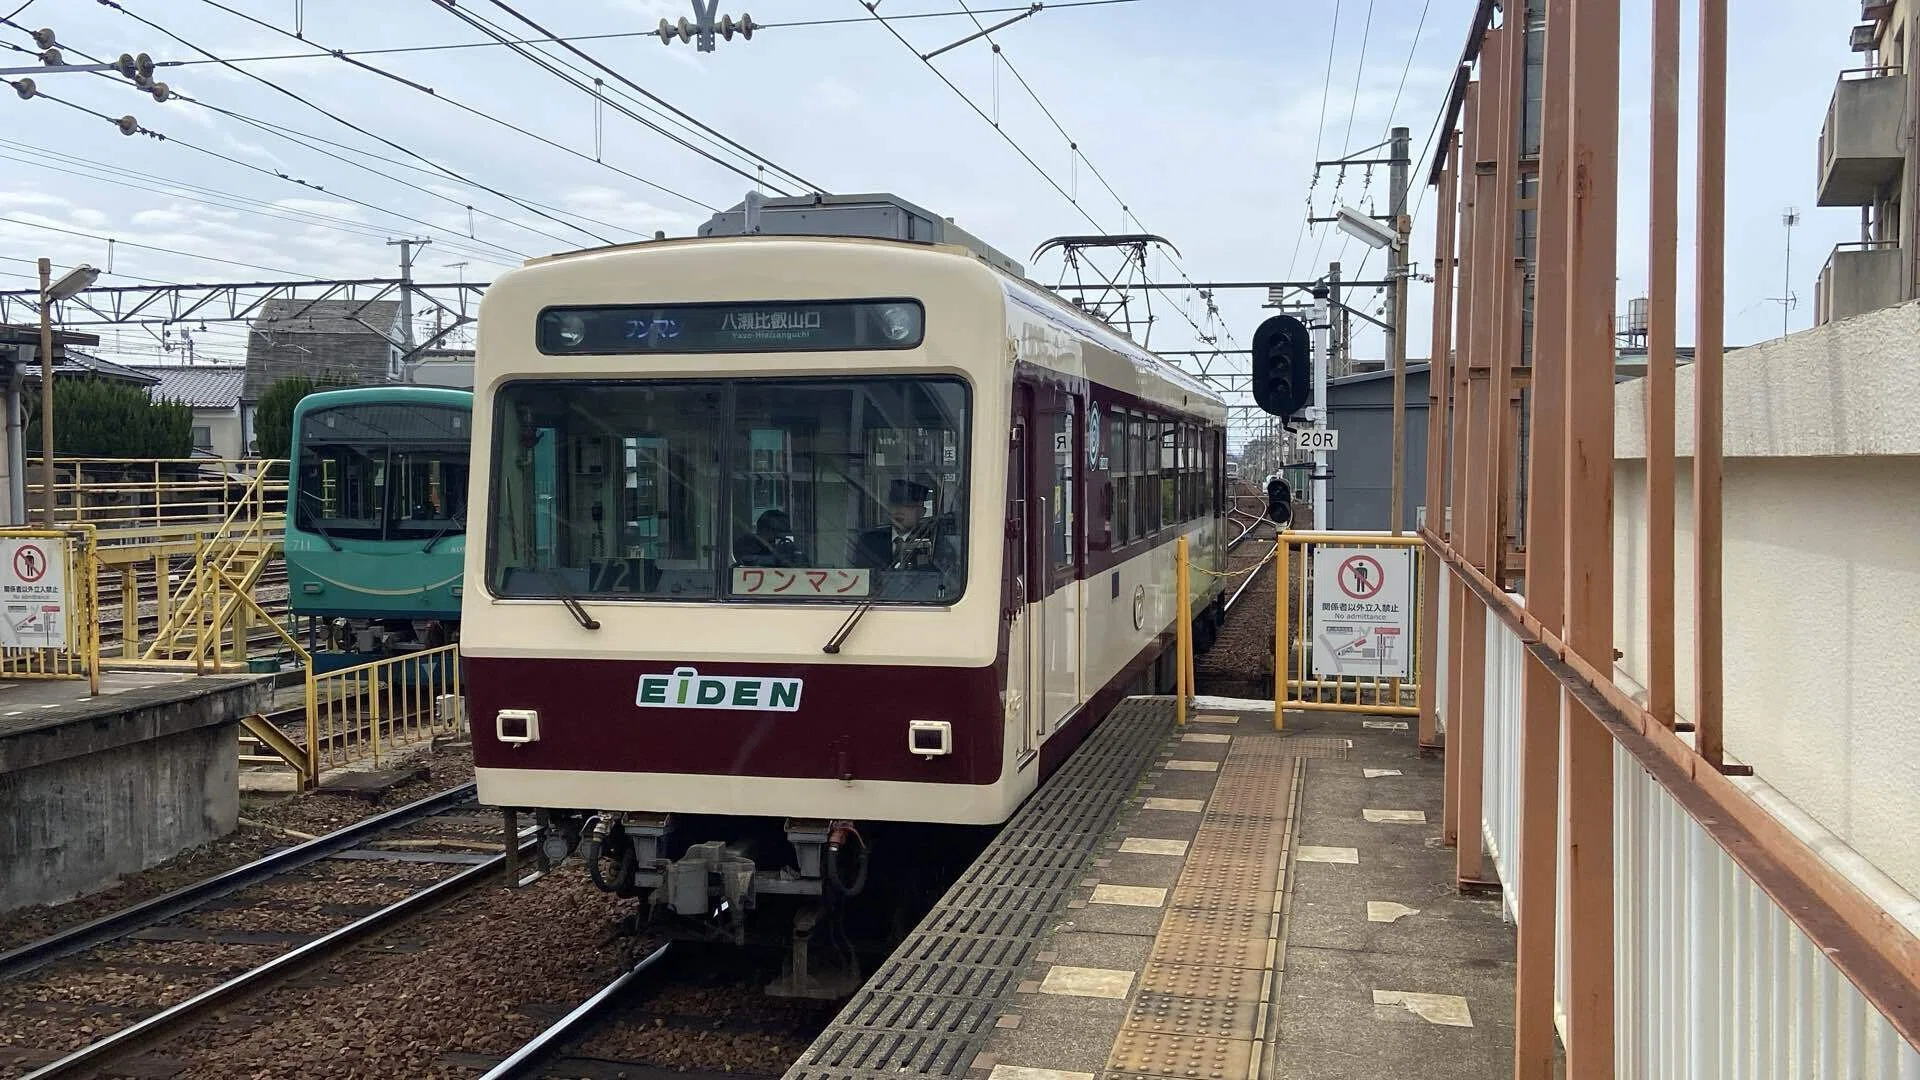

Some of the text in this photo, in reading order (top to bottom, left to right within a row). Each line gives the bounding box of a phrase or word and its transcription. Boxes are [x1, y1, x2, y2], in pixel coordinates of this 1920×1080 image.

[1301, 433, 1333, 447] 20R
[743, 570, 859, 592] ワンマン
[1322, 603, 1399, 612] 関係者以外立入禁止
